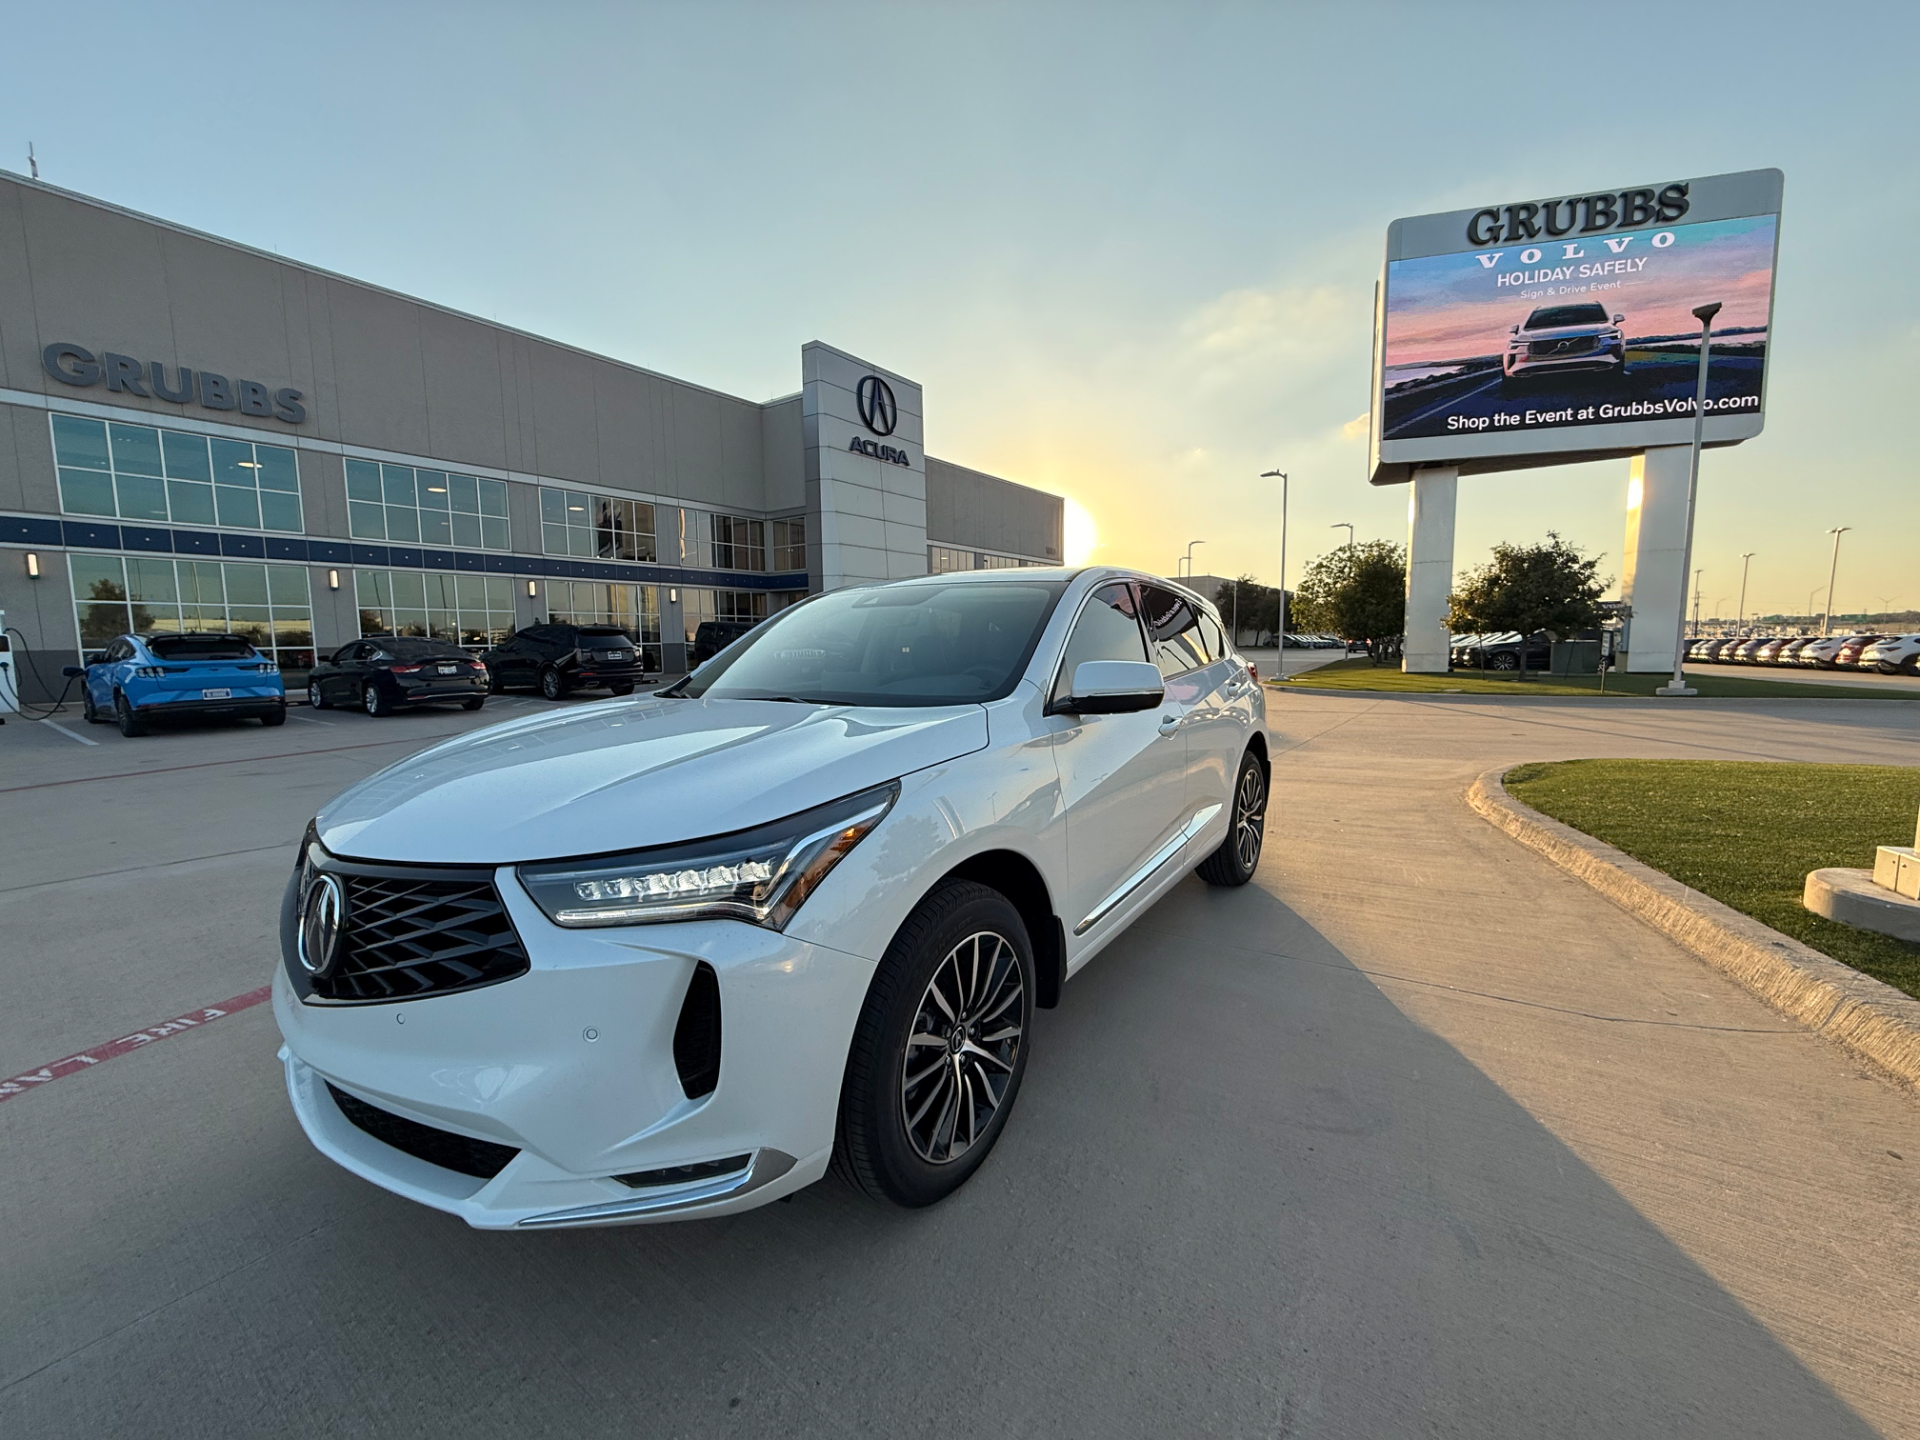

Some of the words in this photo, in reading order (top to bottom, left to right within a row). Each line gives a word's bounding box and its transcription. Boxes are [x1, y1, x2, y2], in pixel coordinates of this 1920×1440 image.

[1467, 182, 1691, 246] GRUBBS
[1475, 231, 1676, 269] VOLVO
[1497, 265, 1575, 287] HOLIDAY
[1578, 257, 1648, 278] SAFELY
[1520, 289, 1544, 300] Sign
[1547, 287, 1556, 296] &
[1559, 284, 1587, 295] Drive
[1590, 280, 1622, 292] Event
[42, 342, 308, 424] GRUBBS
[1447, 415, 1490, 431] Shop
[1493, 412, 1521, 426] the
[1525, 407, 1574, 424] Event
[1577, 405, 1595, 420] at
[849, 436, 910, 467] ACURA
[116, 1008, 227, 1048] FIRE
